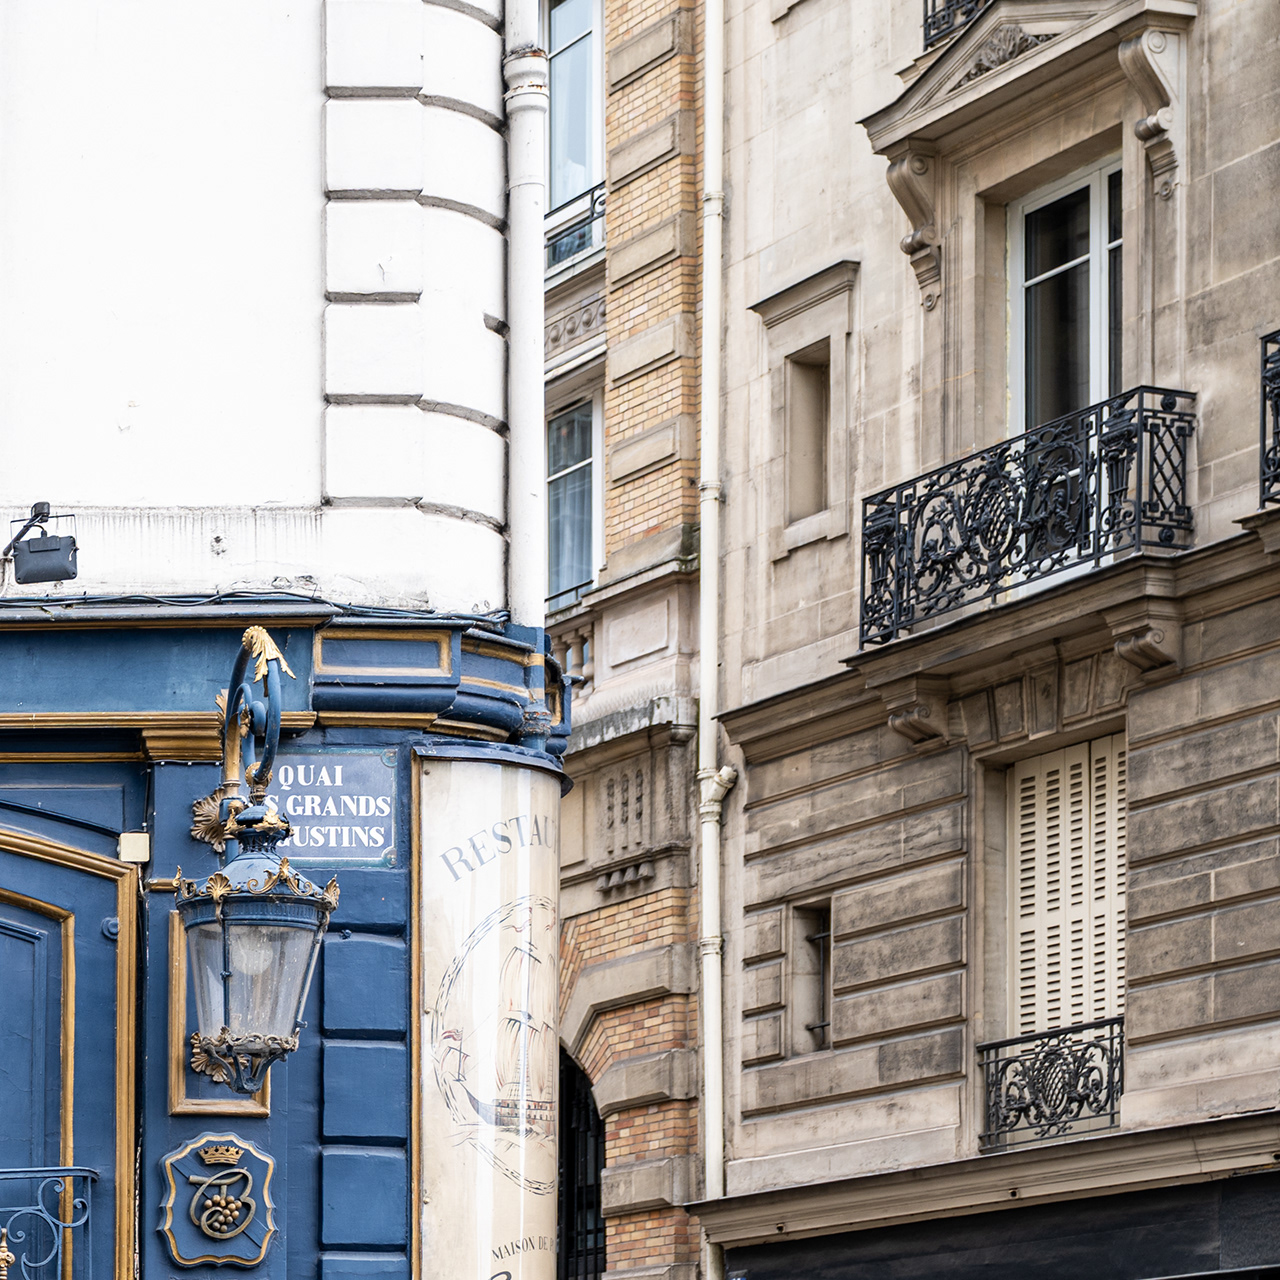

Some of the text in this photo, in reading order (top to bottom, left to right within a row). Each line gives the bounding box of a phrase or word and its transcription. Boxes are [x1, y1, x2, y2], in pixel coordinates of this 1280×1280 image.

[278, 765, 344, 790] QUAI
[286, 795, 391, 817] GRANDS
[274, 826, 385, 847] USTINS
[439, 814, 557, 882] RESTAU
[492, 1235, 535, 1262] MAISON
[538, 1235, 548, 1251] DE
